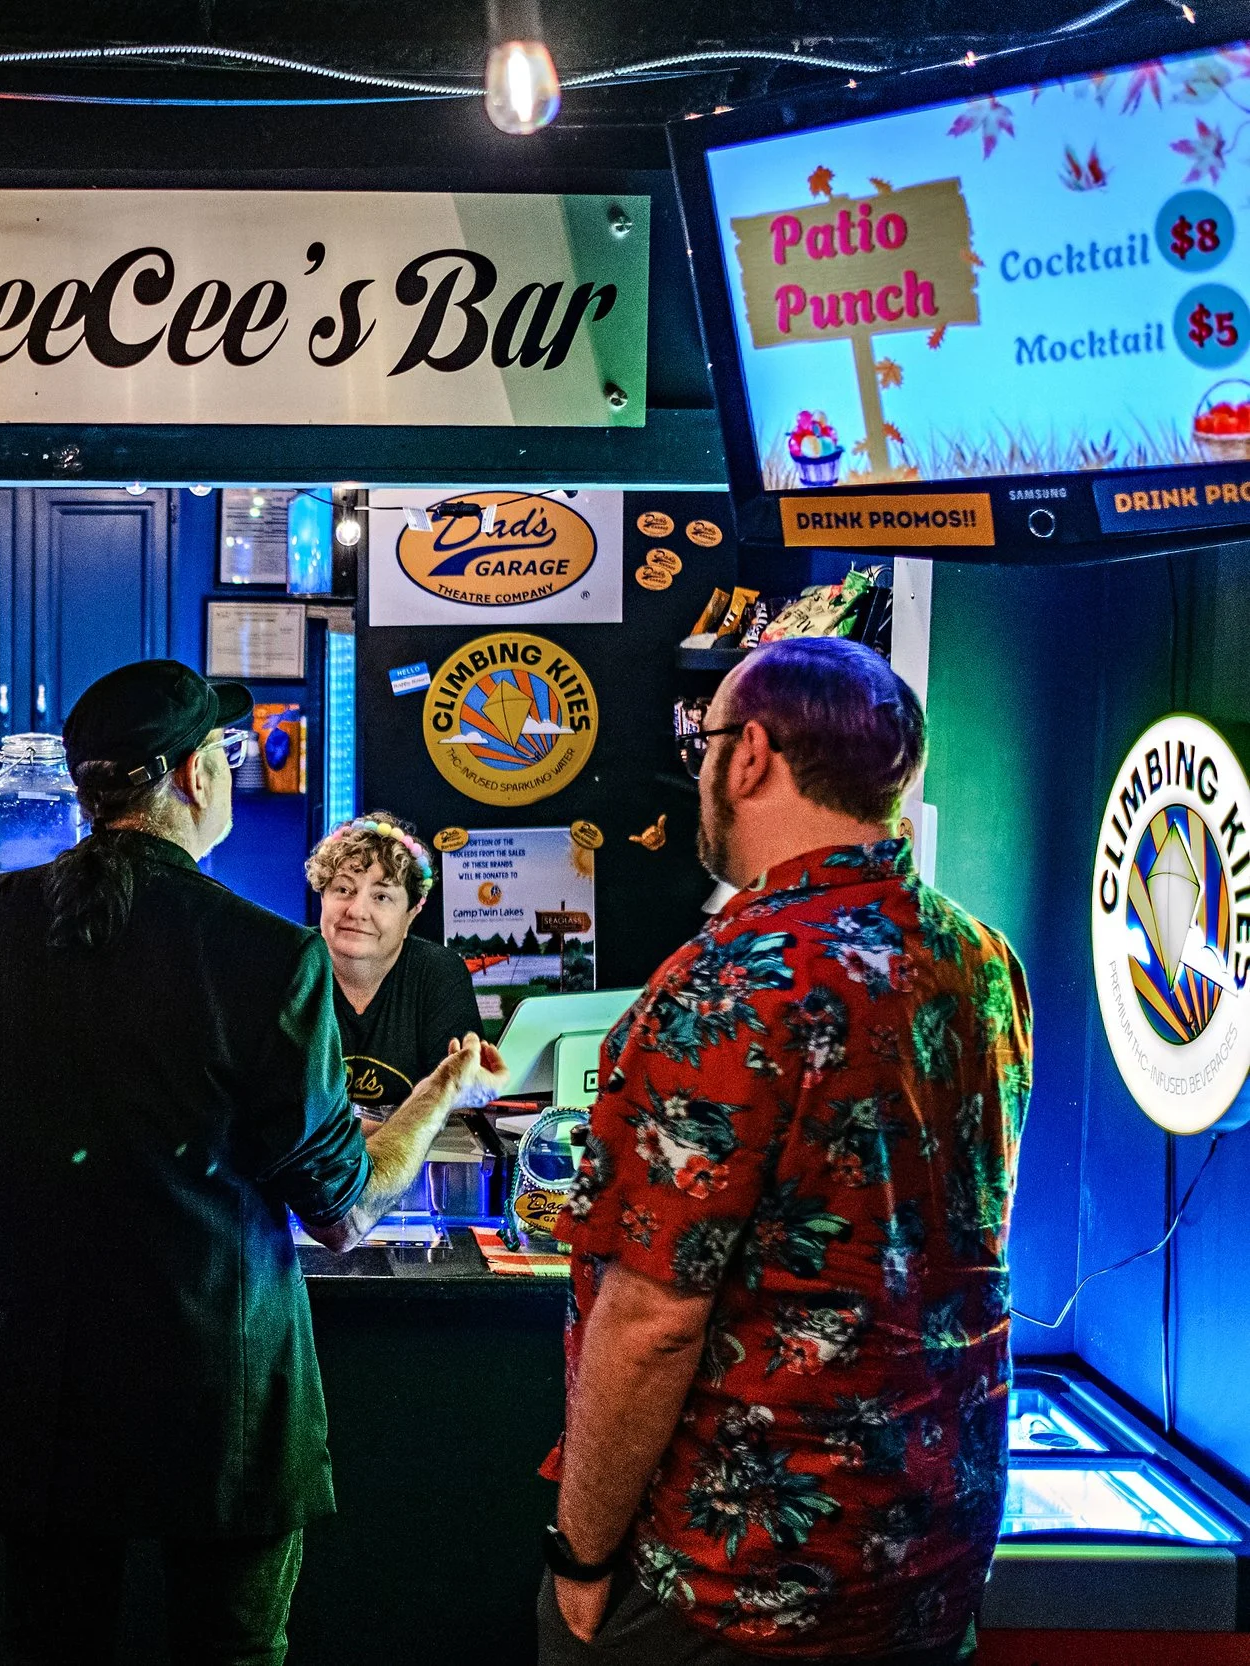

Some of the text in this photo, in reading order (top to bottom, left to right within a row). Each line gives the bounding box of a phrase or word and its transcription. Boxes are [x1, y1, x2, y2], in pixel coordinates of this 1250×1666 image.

[769, 202, 908, 266] Patio
[999, 214, 1221, 282] Cocktail $8
[386, 247, 618, 377] Bar
[774, 269, 939, 334] Punch
[1014, 302, 1239, 367] Mocktail $5
[1008, 487, 1068, 501] SAMSUNG
[1114, 486, 1199, 514] DRINK
[431, 503, 558, 552] Dad's
[796, 509, 978, 530] DRINK PROMOS!!
[475, 559, 570, 577] GARAGE
[438, 583, 554, 605] THEATRE COMPANY
[396, 665, 421, 677] HELLO
[431, 642, 543, 733] CLIMBING
[544, 656, 591, 733] KITES
[446, 747, 576, 792] THC-INFUSED SPARKLING WATER
[1099, 739, 1219, 915] CLIMBING
[508, 849, 526, 857] SALES
[452, 908, 524, 919] Camp Twin Lakes
[1108, 960, 1239, 1096] PREMIUM THC-INFUSED BEVERAGES
